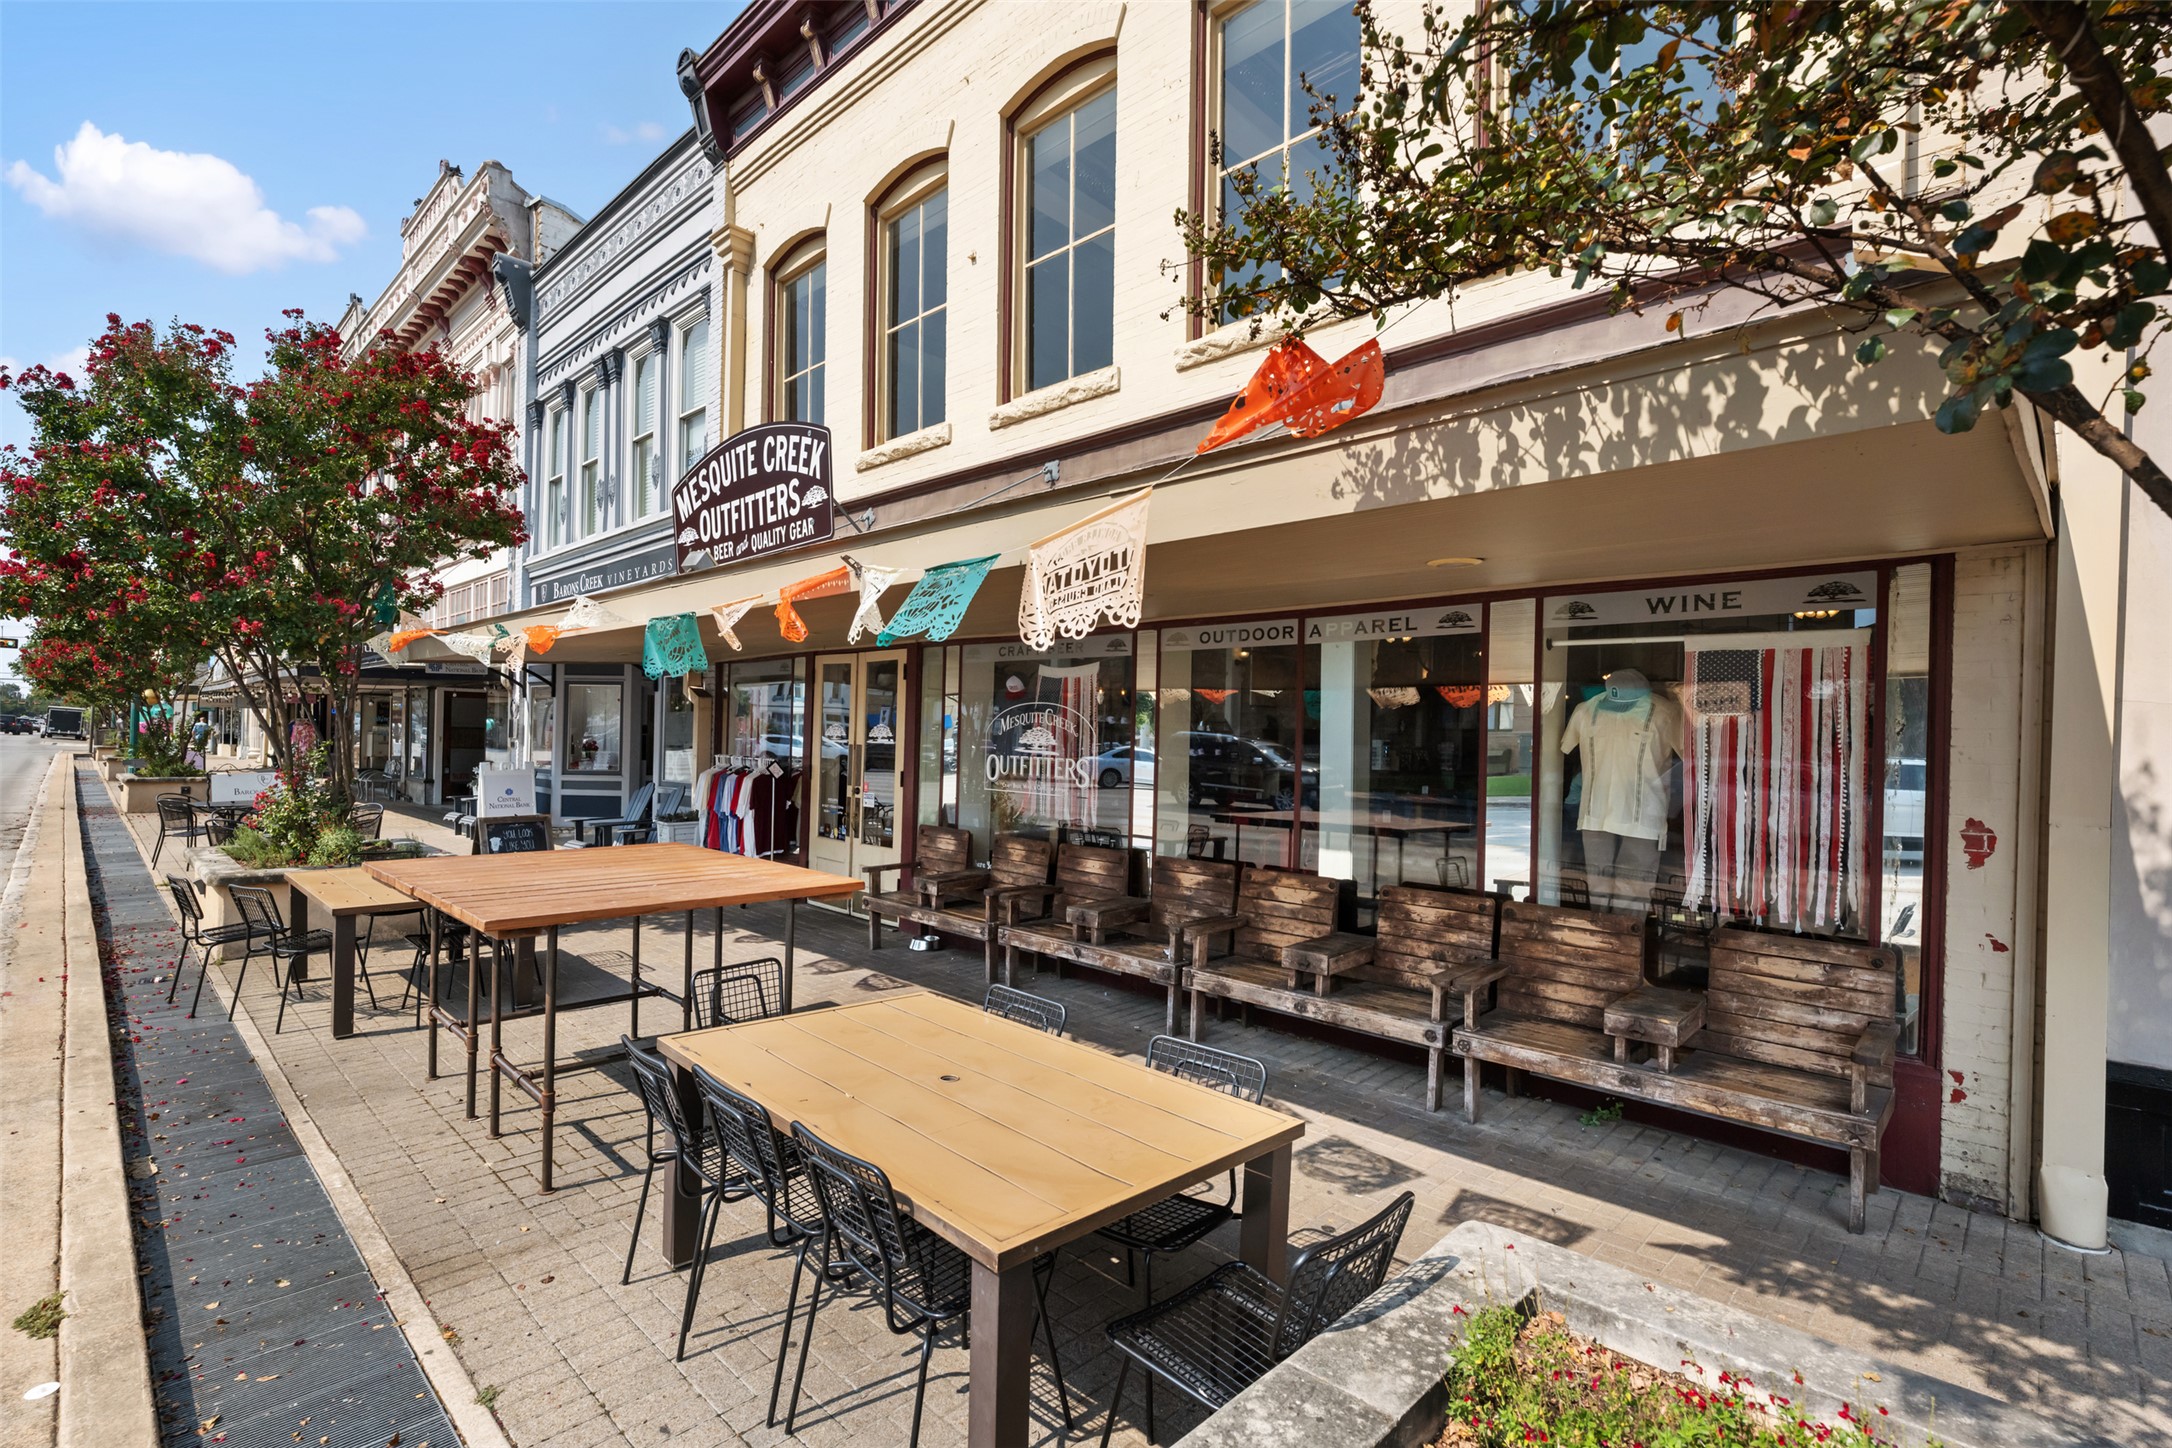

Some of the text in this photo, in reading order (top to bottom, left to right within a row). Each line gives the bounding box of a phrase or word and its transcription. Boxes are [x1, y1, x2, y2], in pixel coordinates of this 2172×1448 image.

[675, 435, 826, 524] MESQUITE CREEK
[699, 478, 800, 543] OUTFITTERS
[713, 541, 734, 561] BEER
[735, 534, 749, 557] and
[751, 526, 787, 553] QUALITY
[789, 518, 815, 541] GEAR
[553, 581, 579, 599] BARONS
[579, 573, 604, 595] CREEK
[607, 558, 673, 586] VINEYARDS
[1645, 590, 1743, 615] WINE
[1199, 617, 1418, 645] OUTDOOR APPAREL
[998, 644, 1041, 657] CRAF
[998, 708, 1079, 738] MESQUITE CREEK
[986, 754, 1090, 789] OUTFITTERS
